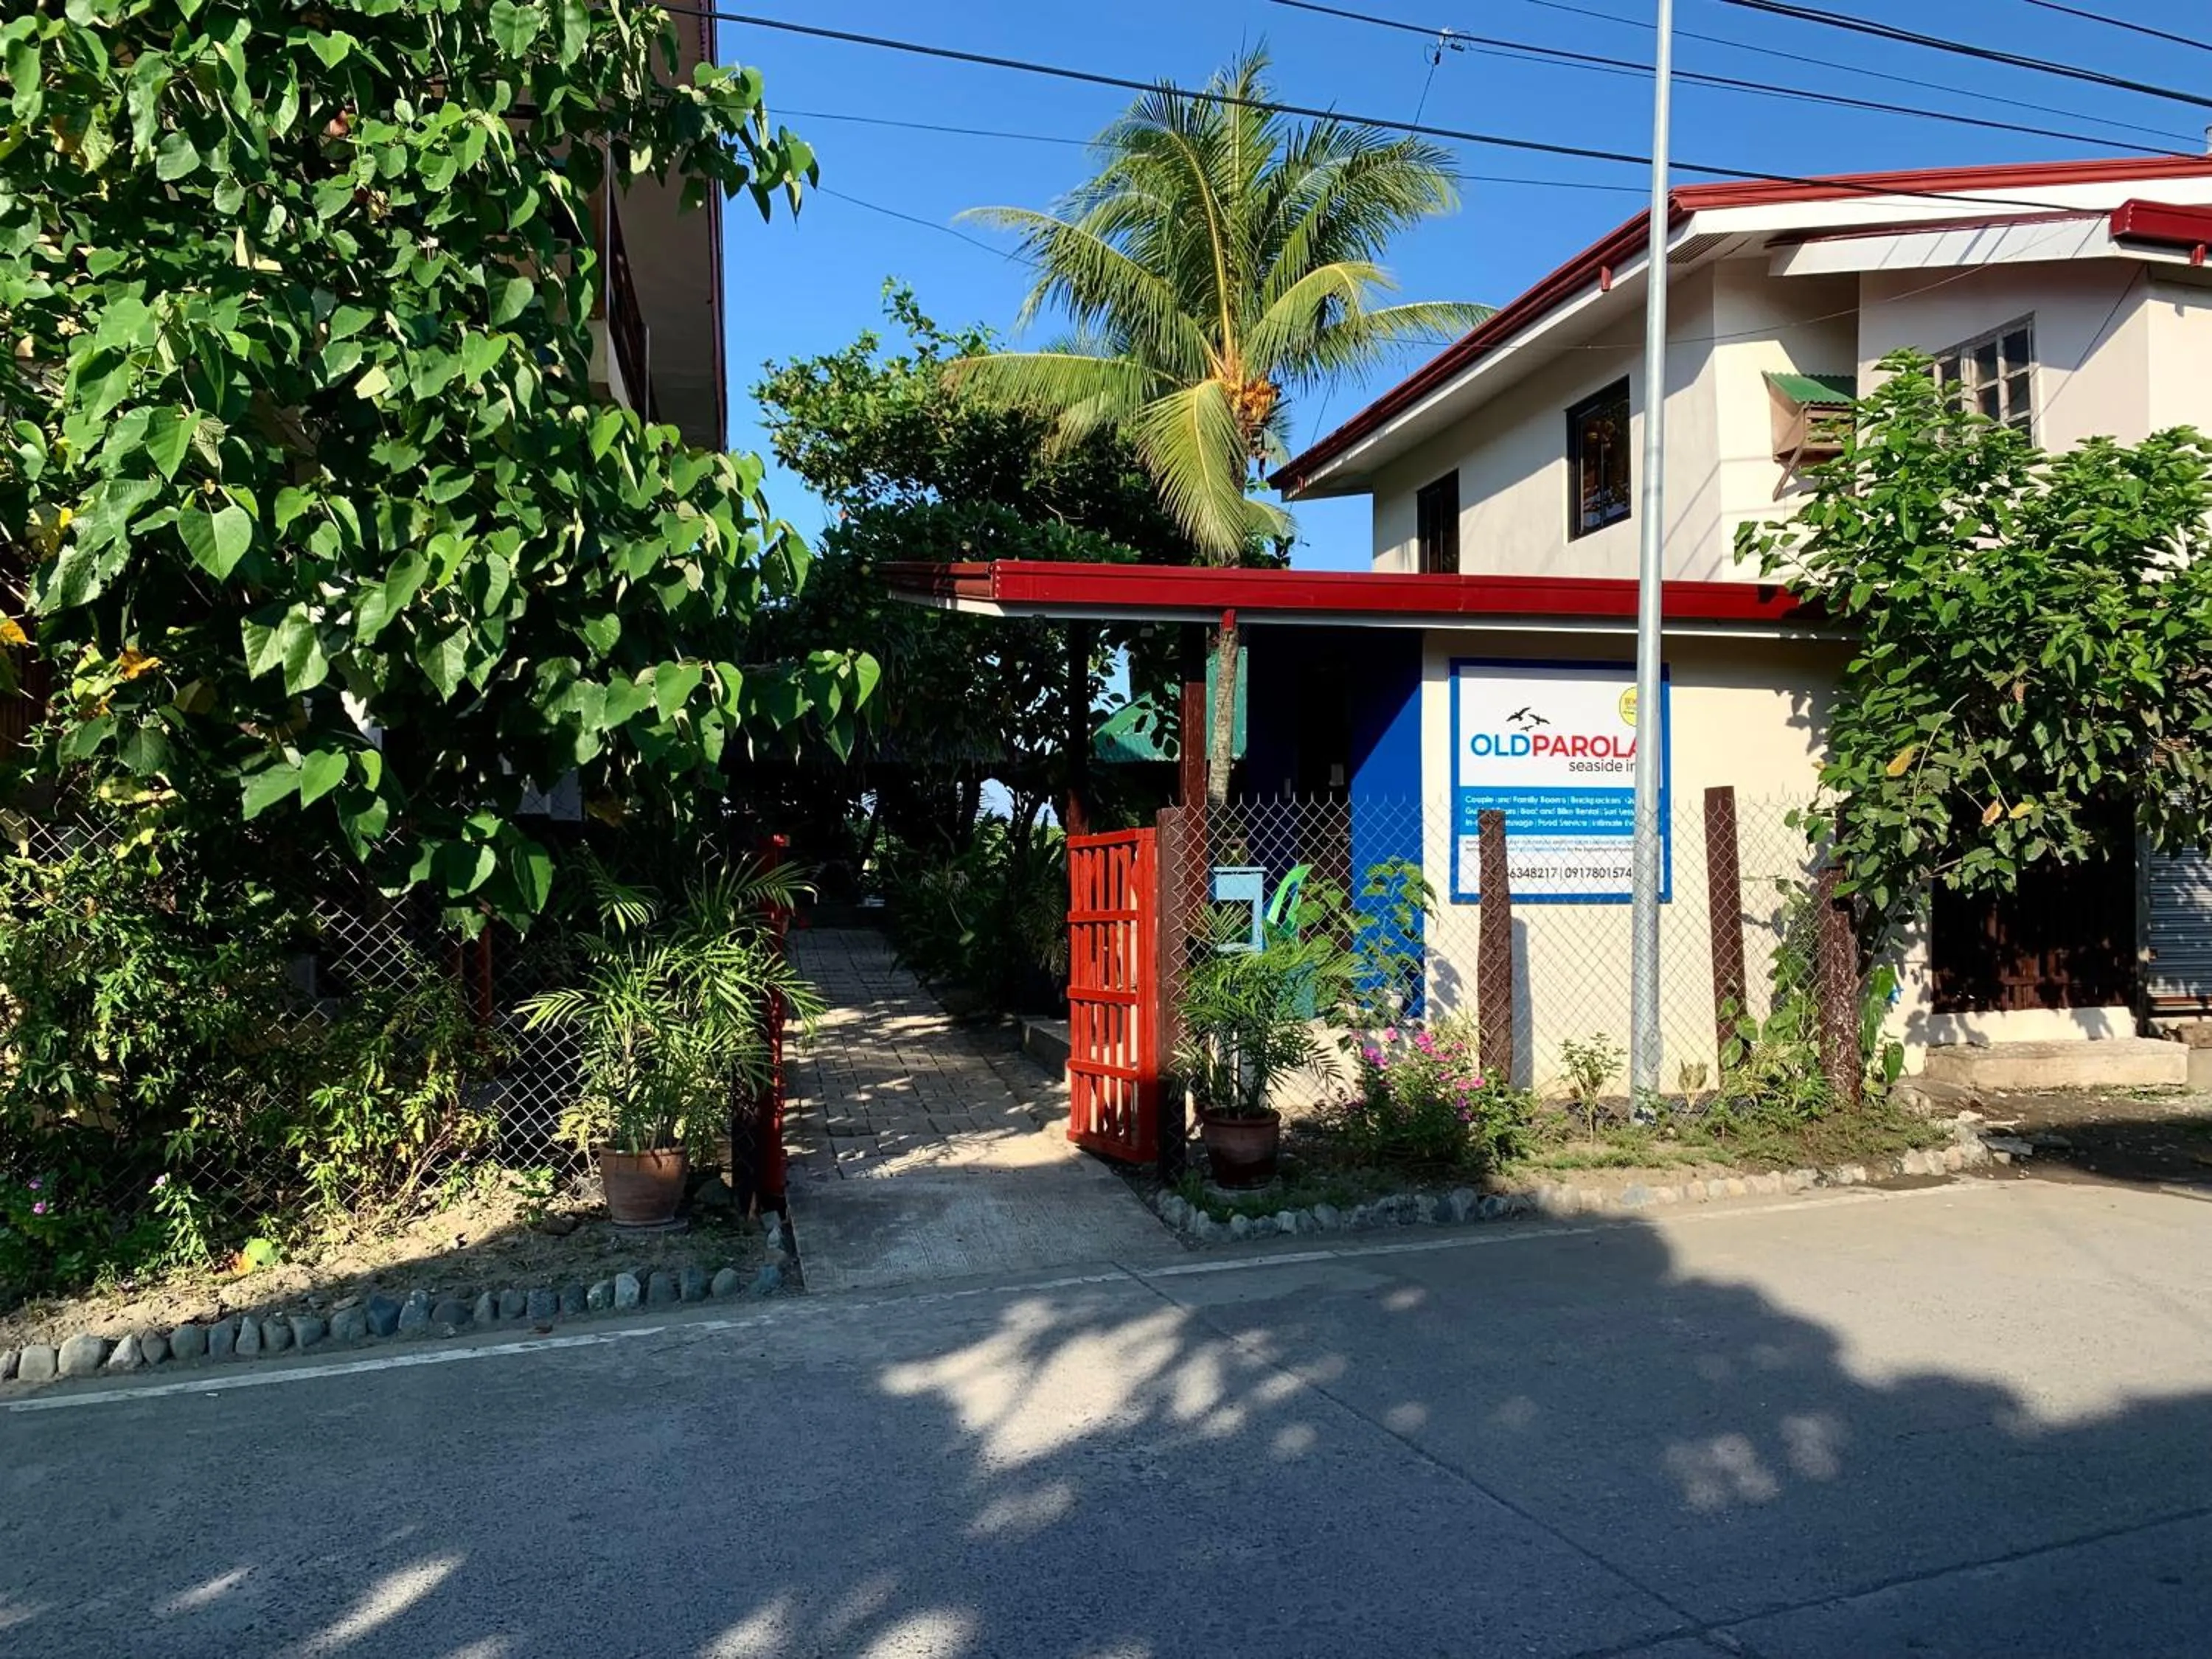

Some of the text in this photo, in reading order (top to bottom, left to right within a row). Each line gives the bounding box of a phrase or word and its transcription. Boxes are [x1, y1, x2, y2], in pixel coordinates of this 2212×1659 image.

[1568, 759, 1636, 772] seaside in
[1465, 796, 1494, 804] Couple
[1513, 796, 1538, 805] Family
[1575, 807, 1599, 815] Rental
[1538, 818, 1558, 827] Food
[1559, 818, 1587, 827] Service
[1507, 867, 1632, 878] 6348217 0917801574
